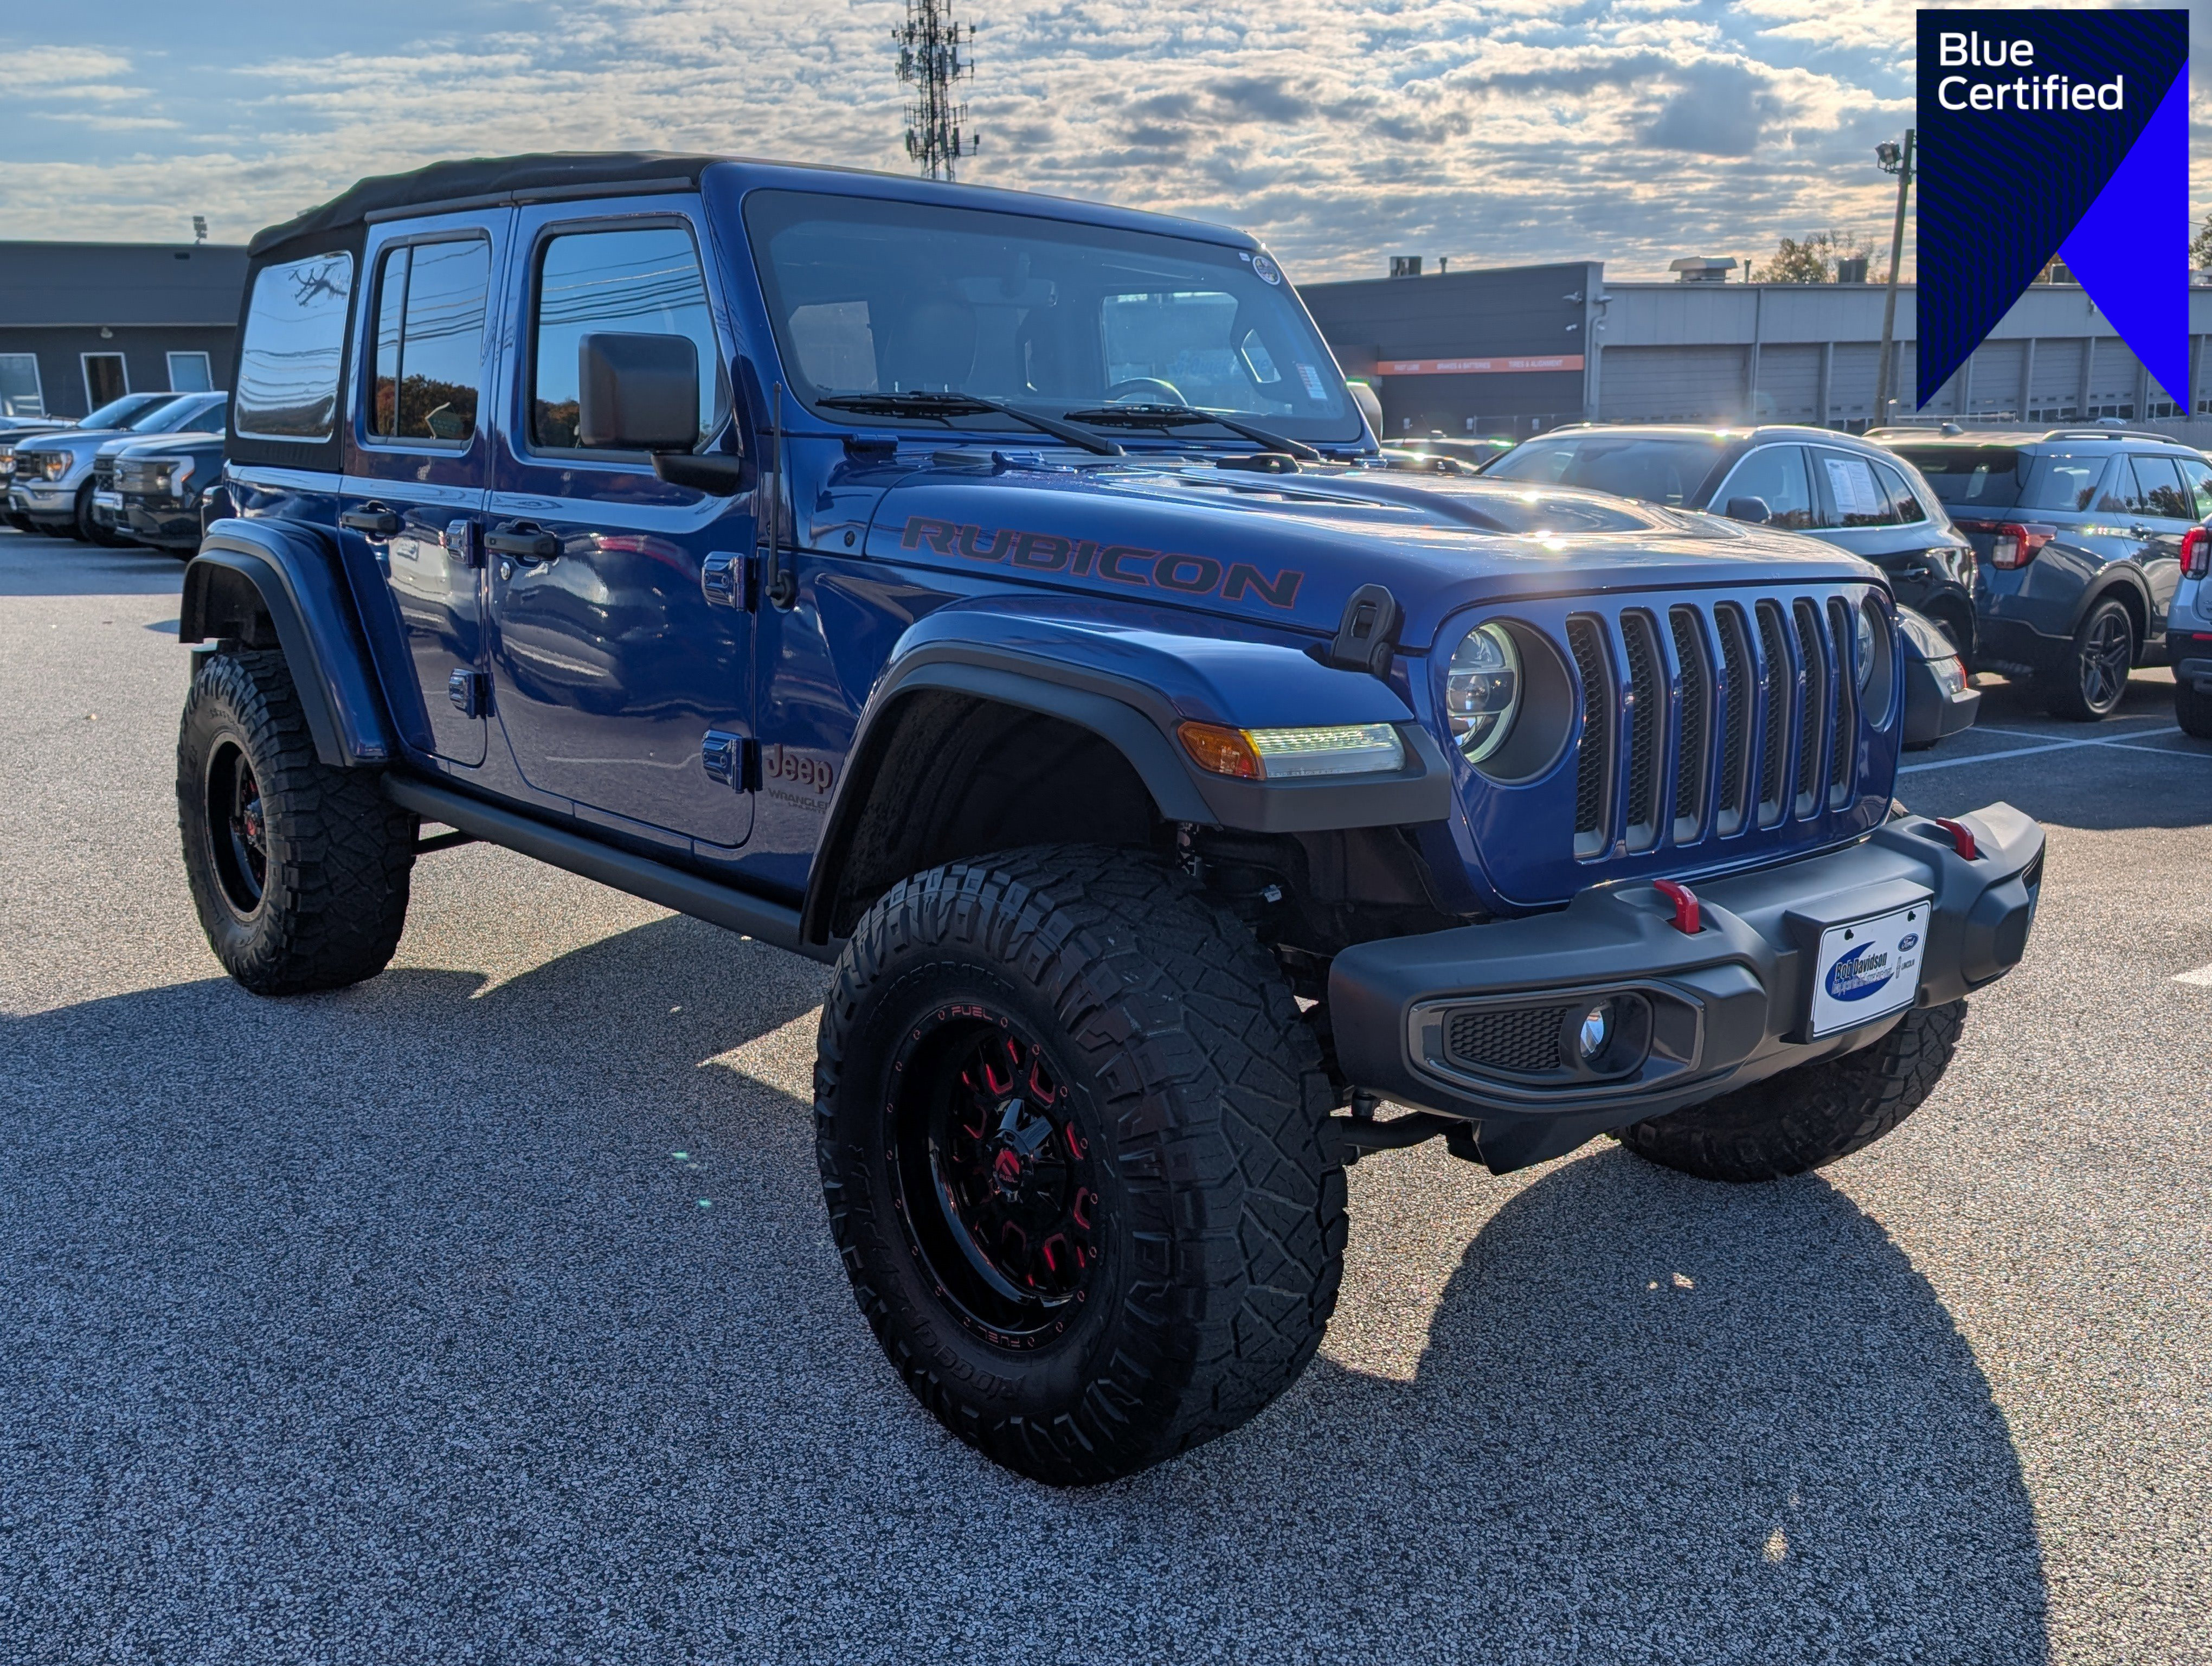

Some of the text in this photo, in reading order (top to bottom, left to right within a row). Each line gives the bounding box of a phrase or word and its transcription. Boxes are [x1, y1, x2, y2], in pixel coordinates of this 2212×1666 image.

[901, 516, 1304, 610] RUBICON
[766, 743, 834, 794] Jeep
[1901, 935, 1916, 949] Ford
[1835, 952, 1888, 981] Bob Davidson
[1901, 958, 1915, 970] LINCOLN
[951, 1005, 993, 1021] FUEL
[978, 1325, 1021, 1348] FUEL
